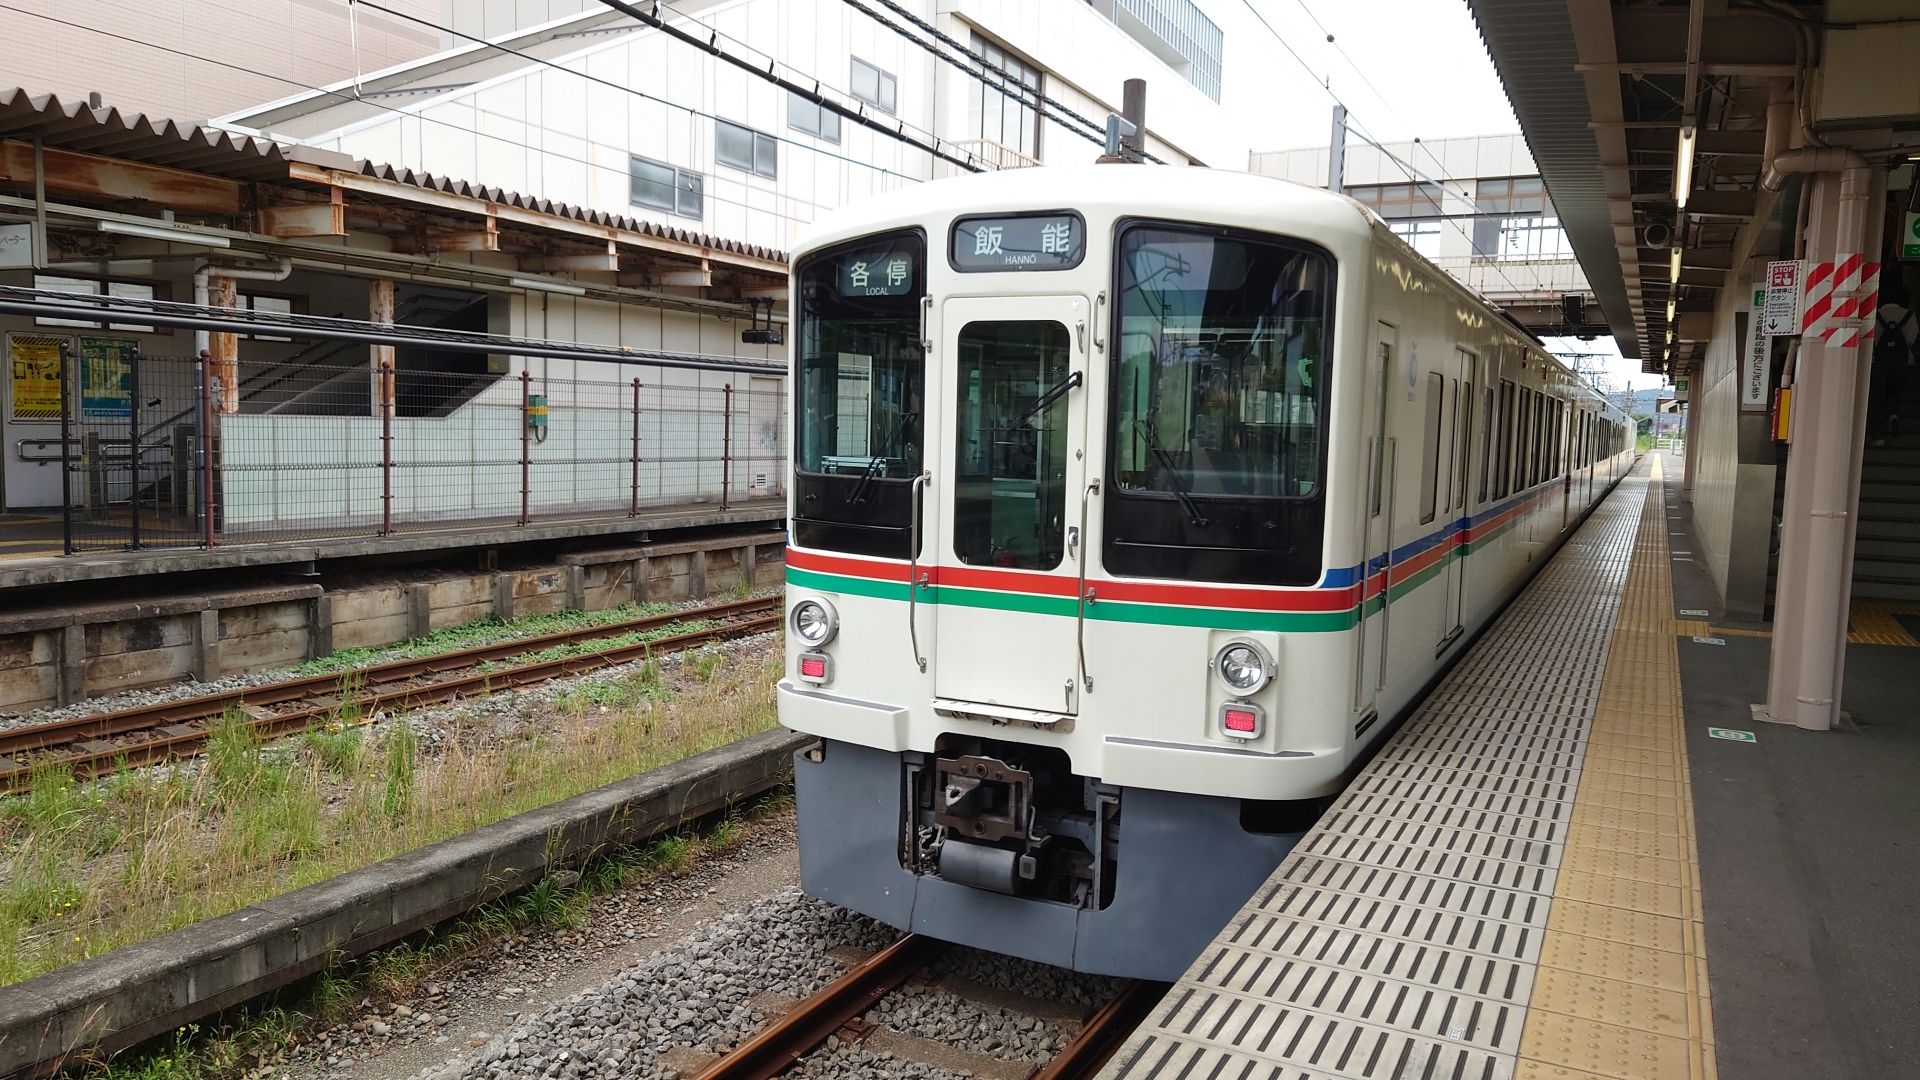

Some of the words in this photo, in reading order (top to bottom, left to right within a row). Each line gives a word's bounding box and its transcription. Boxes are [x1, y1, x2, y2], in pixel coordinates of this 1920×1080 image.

[0, 235, 26, 244] ベーター
[974, 223, 1070, 256] 飯能
[1005, 252, 1037, 264] HANNŌ
[850, 259, 907, 287] 各停
[866, 287, 889, 296] LOCAL
